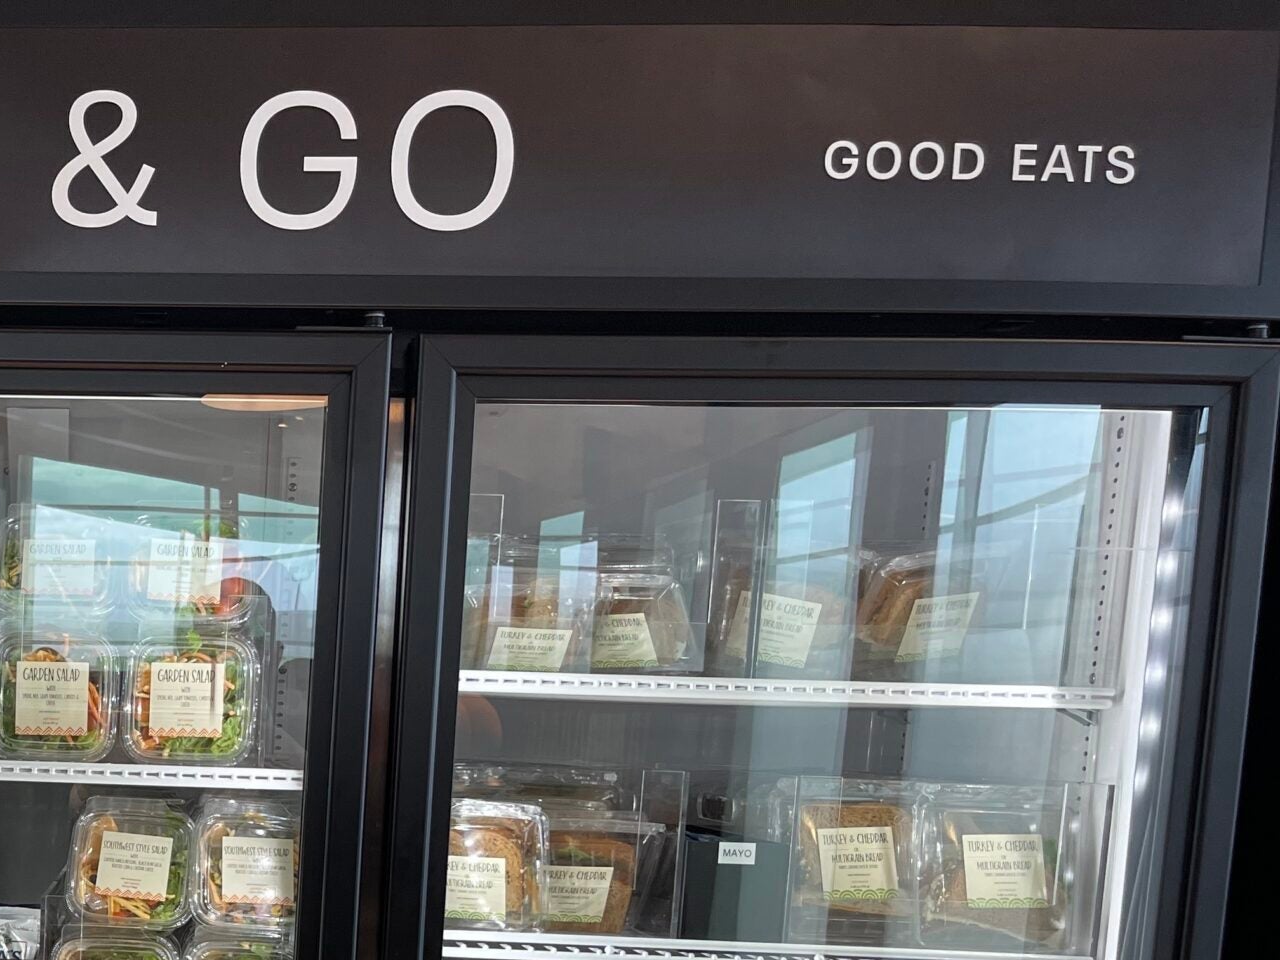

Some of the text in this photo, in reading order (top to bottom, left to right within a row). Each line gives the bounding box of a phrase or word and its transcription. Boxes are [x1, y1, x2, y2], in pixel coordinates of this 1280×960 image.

[51, 89, 158, 228] &
[238, 89, 515, 232] GO
[824, 140, 1135, 184] GOOD EATS
[29, 543, 86, 555] GARDEN SALAD
[157, 543, 214, 559] GARDEN SALAD
[23, 668, 80, 682] GARDEN SALAD
[157, 669, 215, 683] GARDEN SALAD
[823, 834, 847, 846] TURKEY
[857, 833, 888, 844] CHEDDAR
[967, 840, 995, 851] TURKEY
[103, 840, 167, 855] SOUTHWEST STYLE SALAD
[273, 848, 290, 857] SALAD
[722, 848, 752, 858] MAYO
